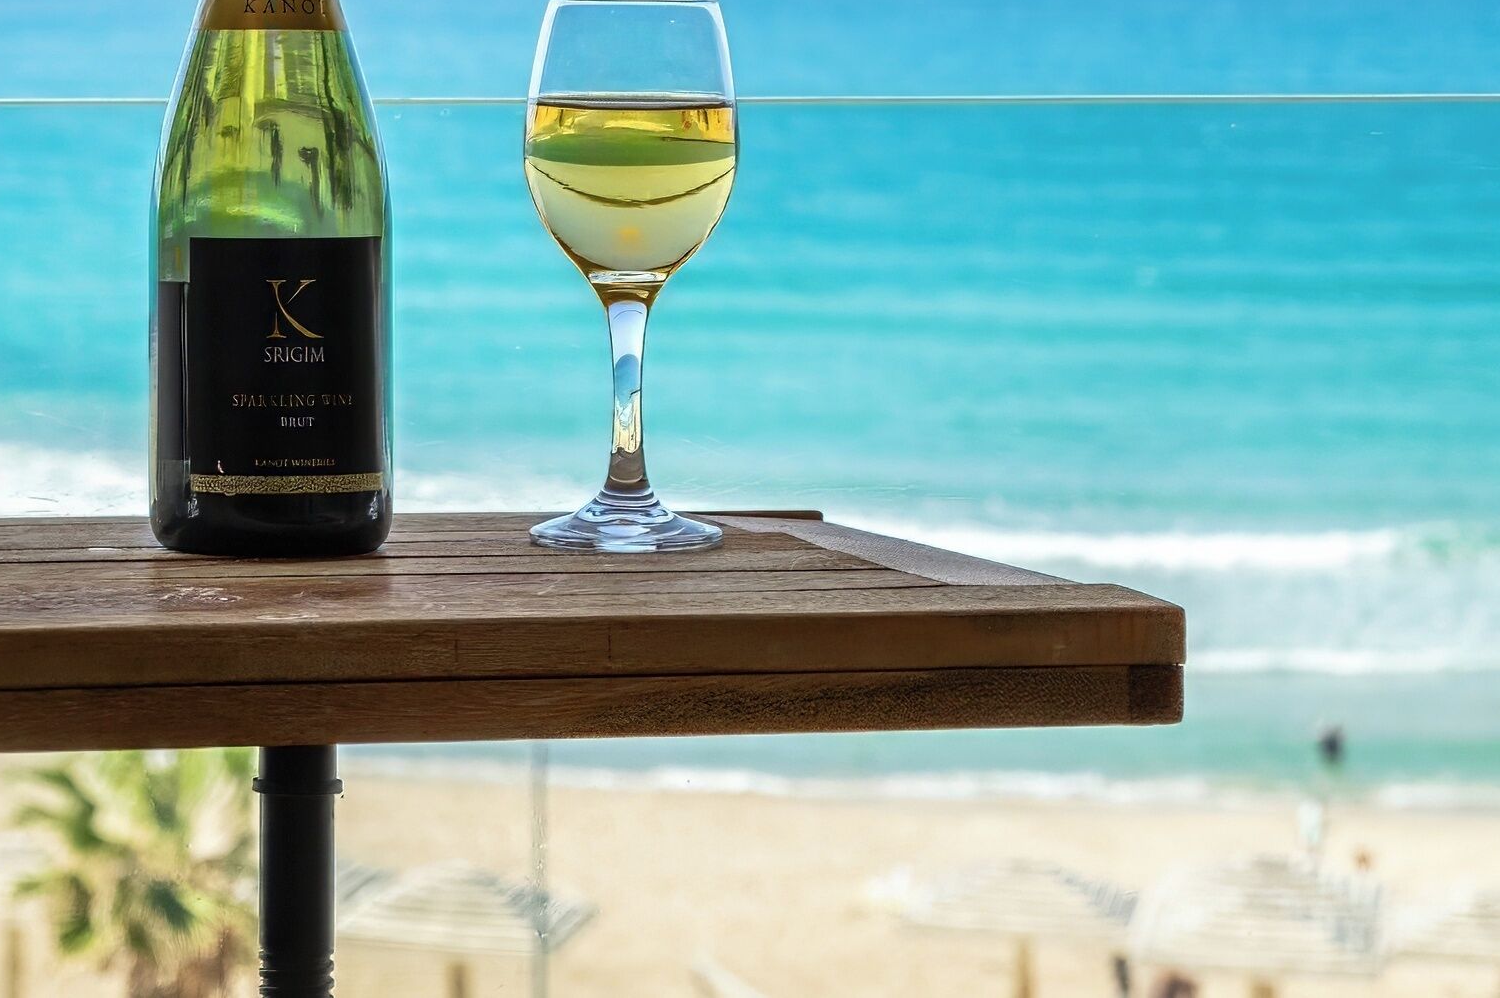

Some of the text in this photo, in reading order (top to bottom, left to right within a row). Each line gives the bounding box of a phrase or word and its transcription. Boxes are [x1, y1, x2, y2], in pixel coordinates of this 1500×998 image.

[265, 279, 325, 339] K
[264, 346, 325, 363] SRIGIM
[232, 393, 316, 408] SPARKLING
[280, 416, 316, 428] BRUT
